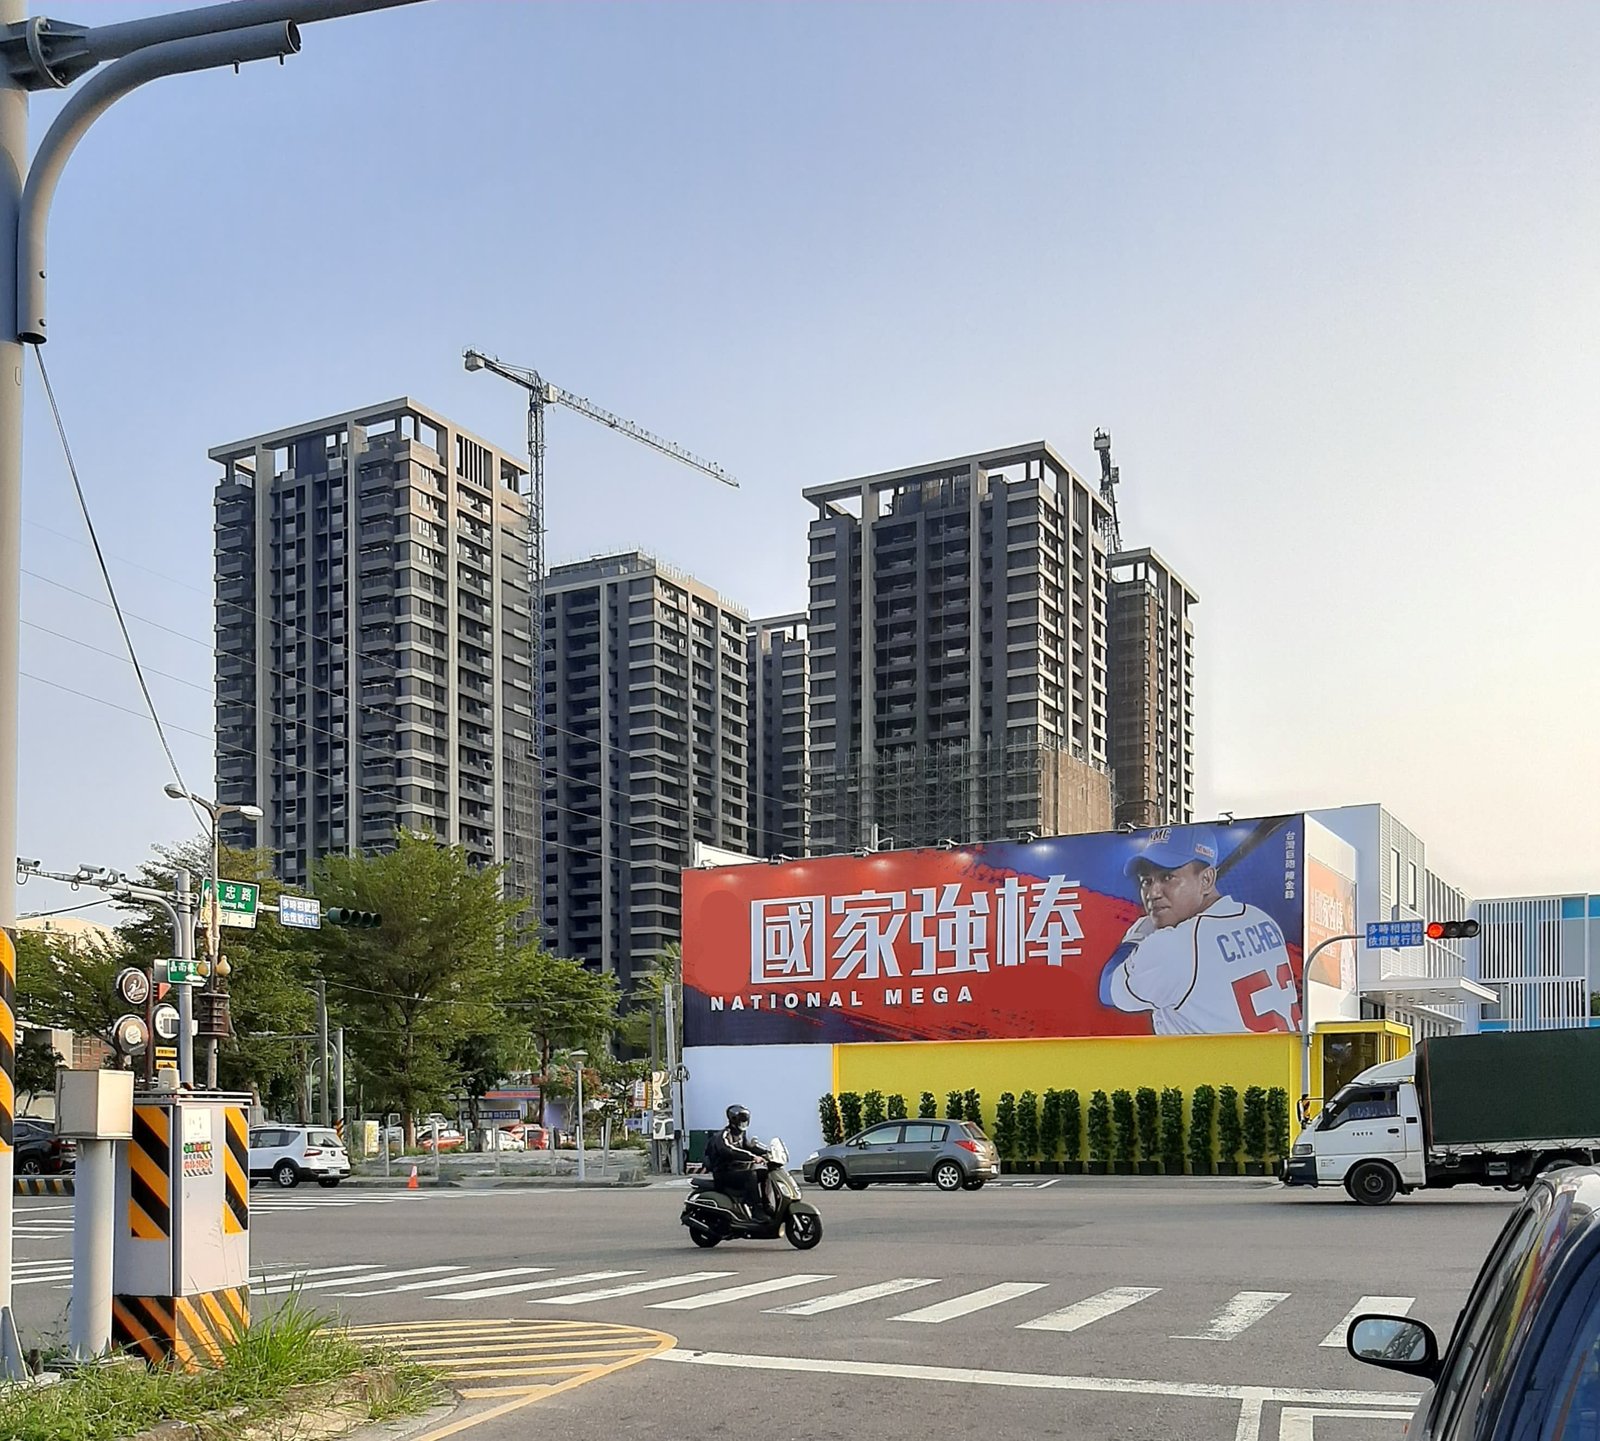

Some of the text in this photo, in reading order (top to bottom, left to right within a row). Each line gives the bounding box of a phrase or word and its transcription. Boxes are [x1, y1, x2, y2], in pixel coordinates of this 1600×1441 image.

[751, 874, 1084, 984] 國家強棒
[1368, 922, 1421, 935] 多時相號誌
[1368, 935, 1422, 947] 依燈號行駛
[710, 985, 973, 1012] NATIONAL MEGA
